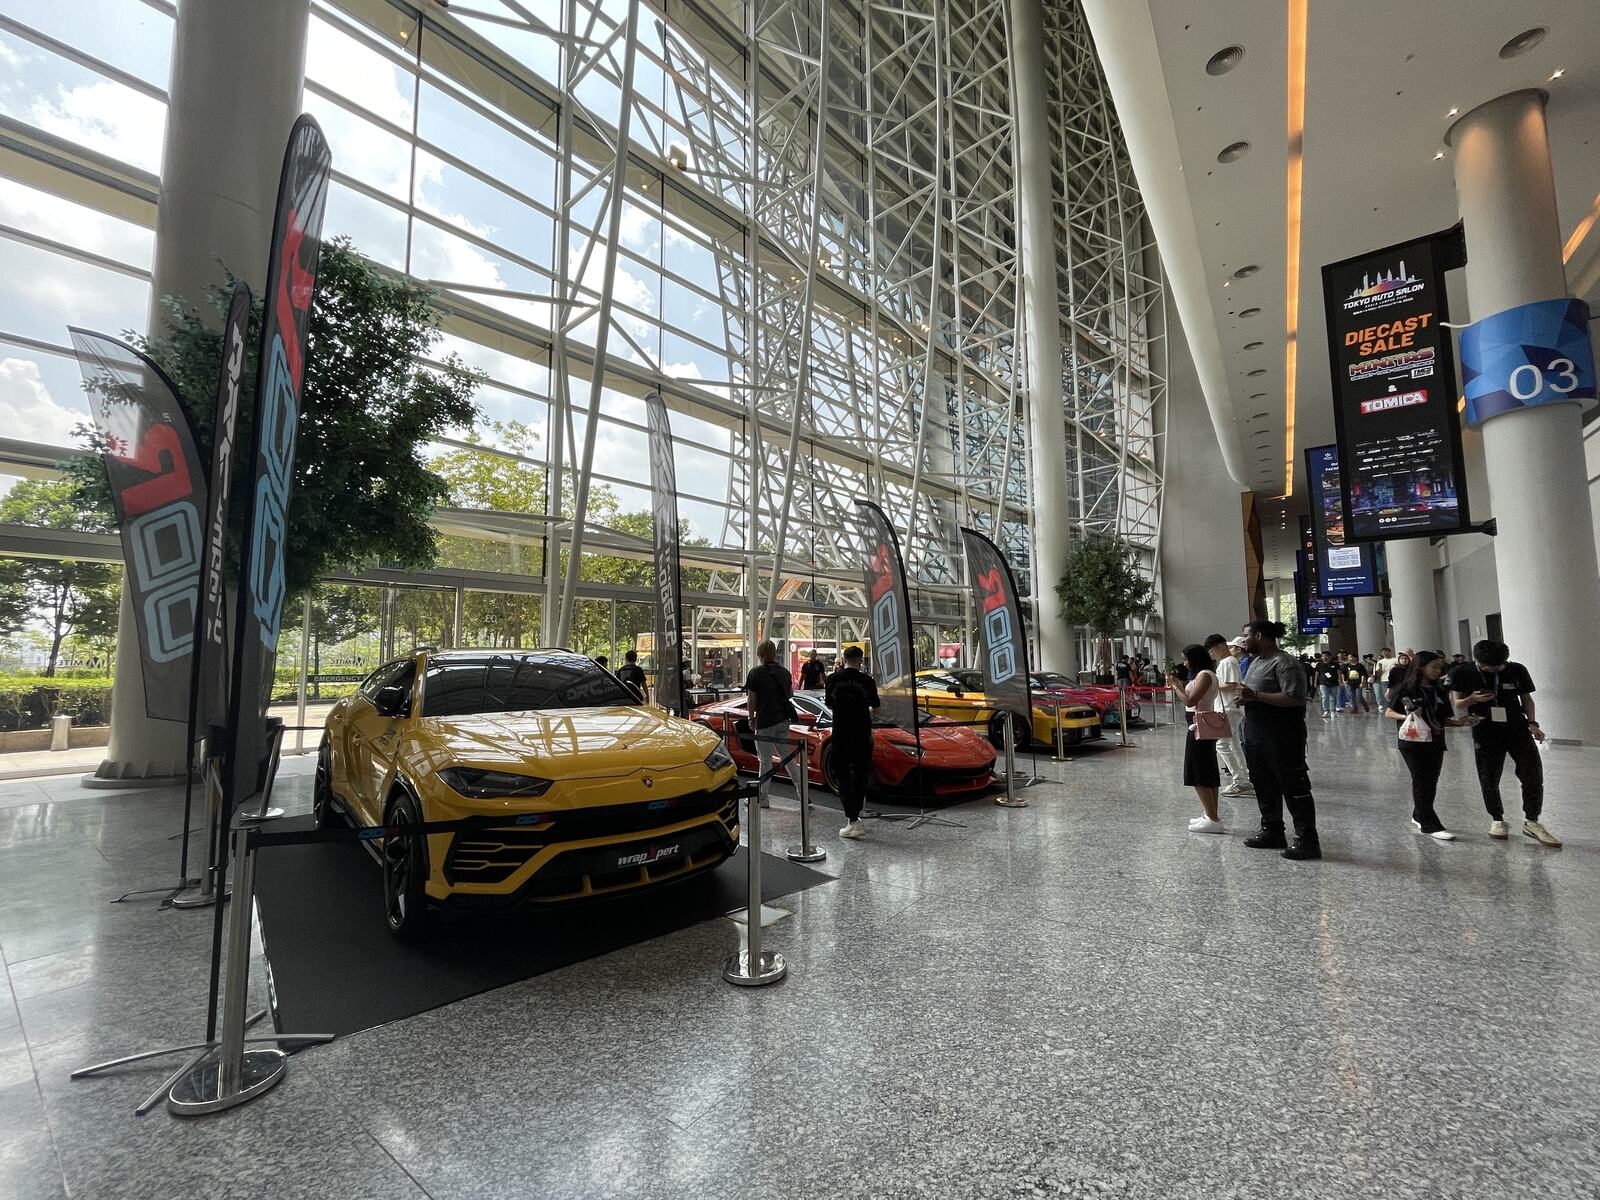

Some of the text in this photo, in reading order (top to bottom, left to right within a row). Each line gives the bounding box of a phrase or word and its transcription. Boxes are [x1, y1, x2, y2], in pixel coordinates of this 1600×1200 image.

[1343, 297, 1371, 310] TOKYO
[1371, 291, 1395, 303] AUTO
[1395, 283, 1425, 296] SALON
[1345, 313, 1433, 346] DIECAST
[1359, 332, 1415, 356] SALE
[1388, 384, 1397, 392] &
[1509, 358, 1579, 400] 03
[1364, 391, 1424, 411] TOMICA
